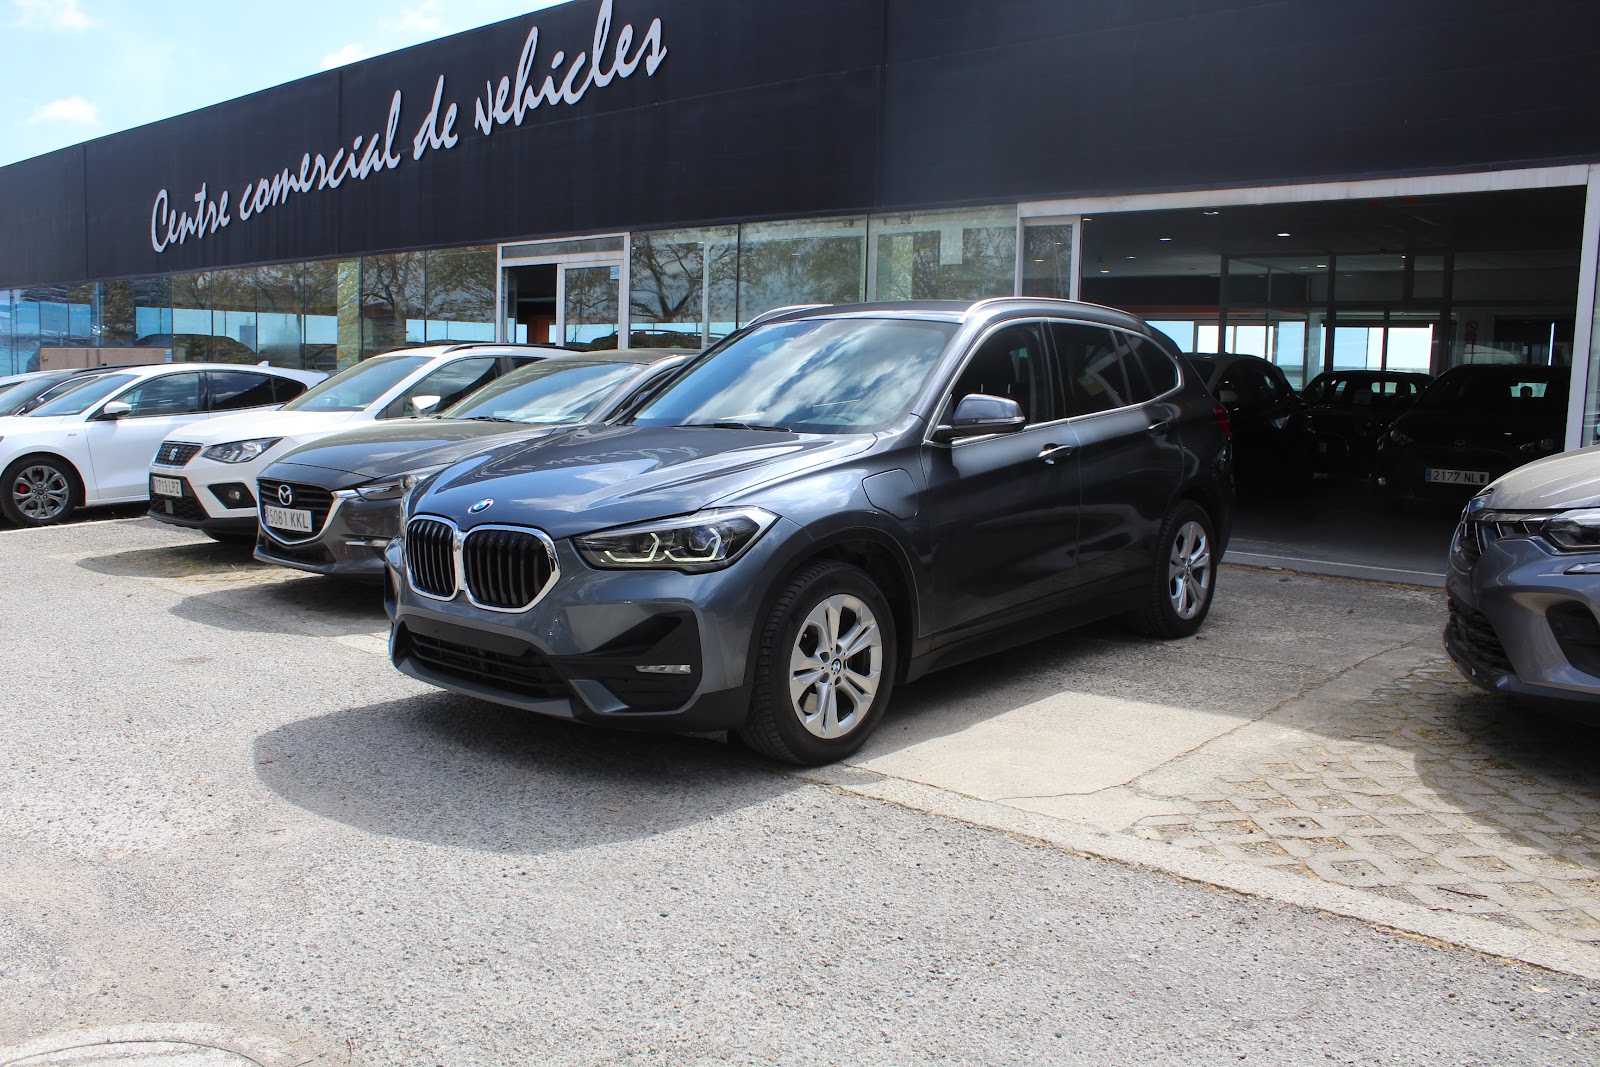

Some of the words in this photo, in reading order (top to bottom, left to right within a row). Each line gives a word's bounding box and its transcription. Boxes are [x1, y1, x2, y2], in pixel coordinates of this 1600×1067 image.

[150, 182, 231, 253] Centre
[239, 89, 402, 221] comercial
[413, 74, 459, 161] de
[474, 0, 668, 136] vehicles
[1433, 470, 1460, 482] 2177
[269, 509, 288, 527] 5061
[290, 511, 309, 529] KKL
